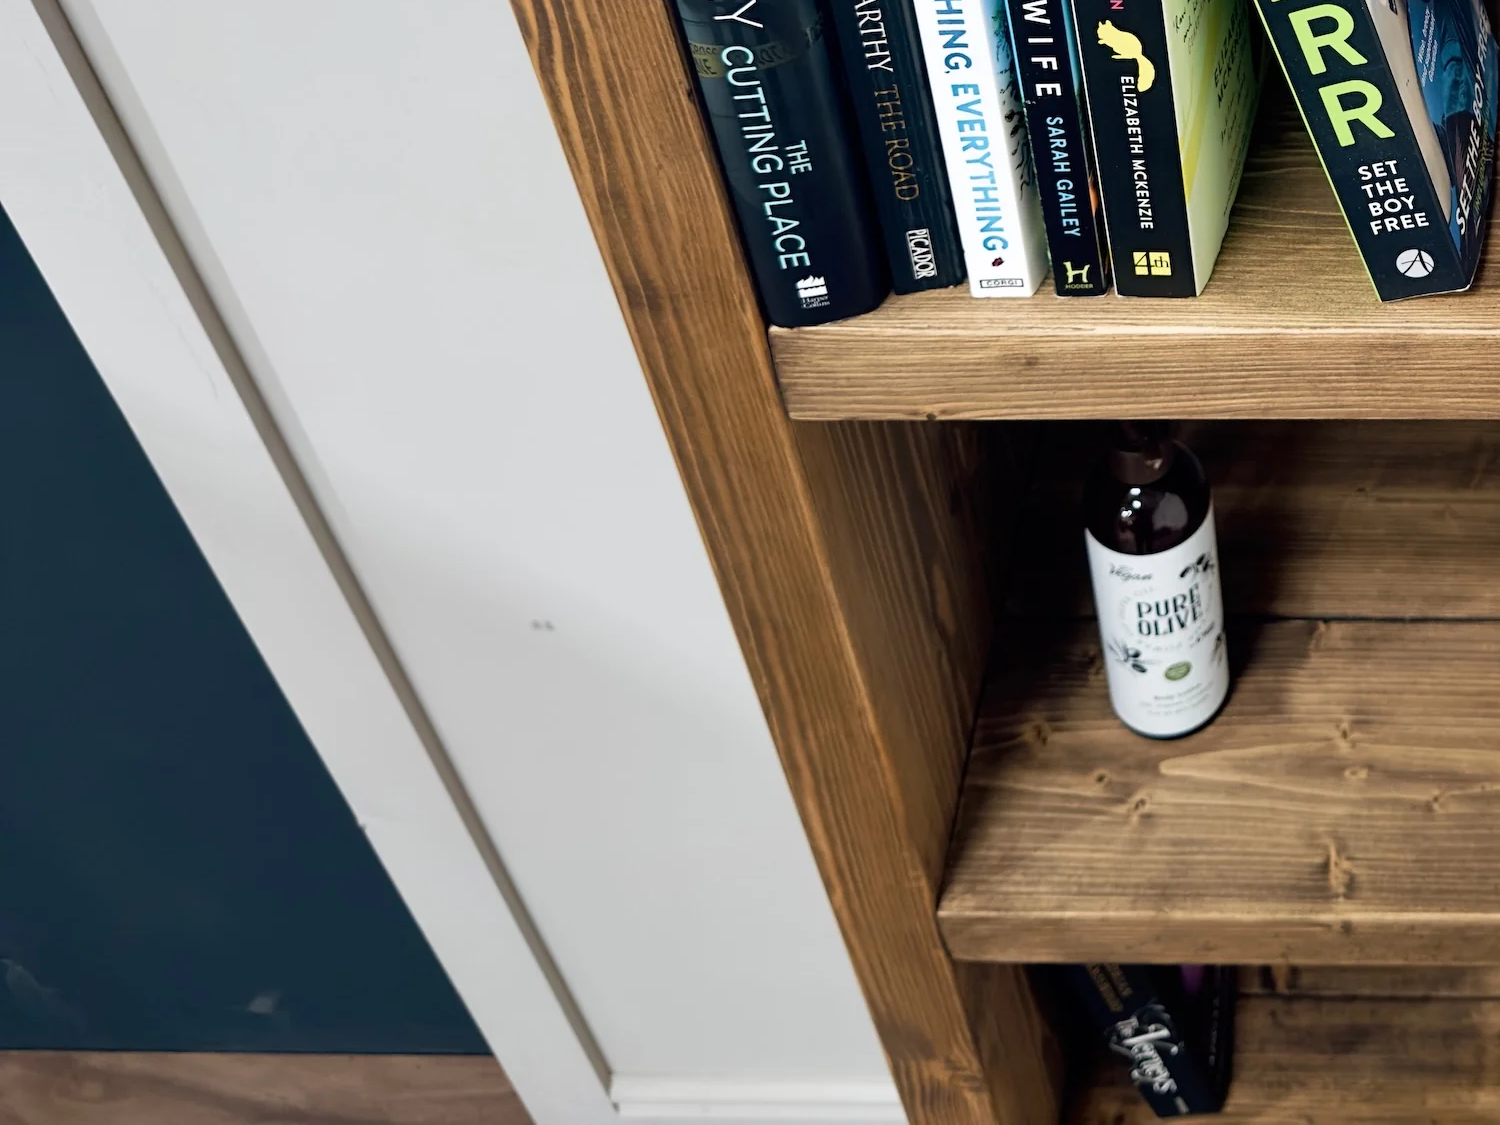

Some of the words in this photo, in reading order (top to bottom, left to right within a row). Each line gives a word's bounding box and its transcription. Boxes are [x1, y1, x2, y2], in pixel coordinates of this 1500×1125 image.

[1022, 0, 1062, 97] WIFE
[873, 83, 905, 132] THE
[1472, 65, 1486, 126] BOY
[721, 46, 783, 174] CUTTING
[760, 181, 811, 270] PLACE
[784, 139, 812, 174] THE
[951, 83, 1009, 252] EVERYTHING
[1046, 116, 1072, 172] SARAH
[1120, 76, 1144, 154] ELIZABETH
[1132, 160, 1154, 229] MCKENZIE
[1357, 160, 1398, 180] SET
[1466, 119, 1481, 179] THE
[885, 139, 920, 202] ROAD
[1361, 177, 1409, 198] THE
[1056, 179, 1081, 237] GAILEY
[1367, 195, 1415, 217] BOY
[1370, 212, 1429, 235] FREE
[1455, 174, 1473, 236] SET
[907, 229, 937, 278] PICADOR
[986, 279, 1018, 287] CORGI
[1137, 582, 1201, 620] PURE
[1138, 600, 1203, 637] OLIVE
